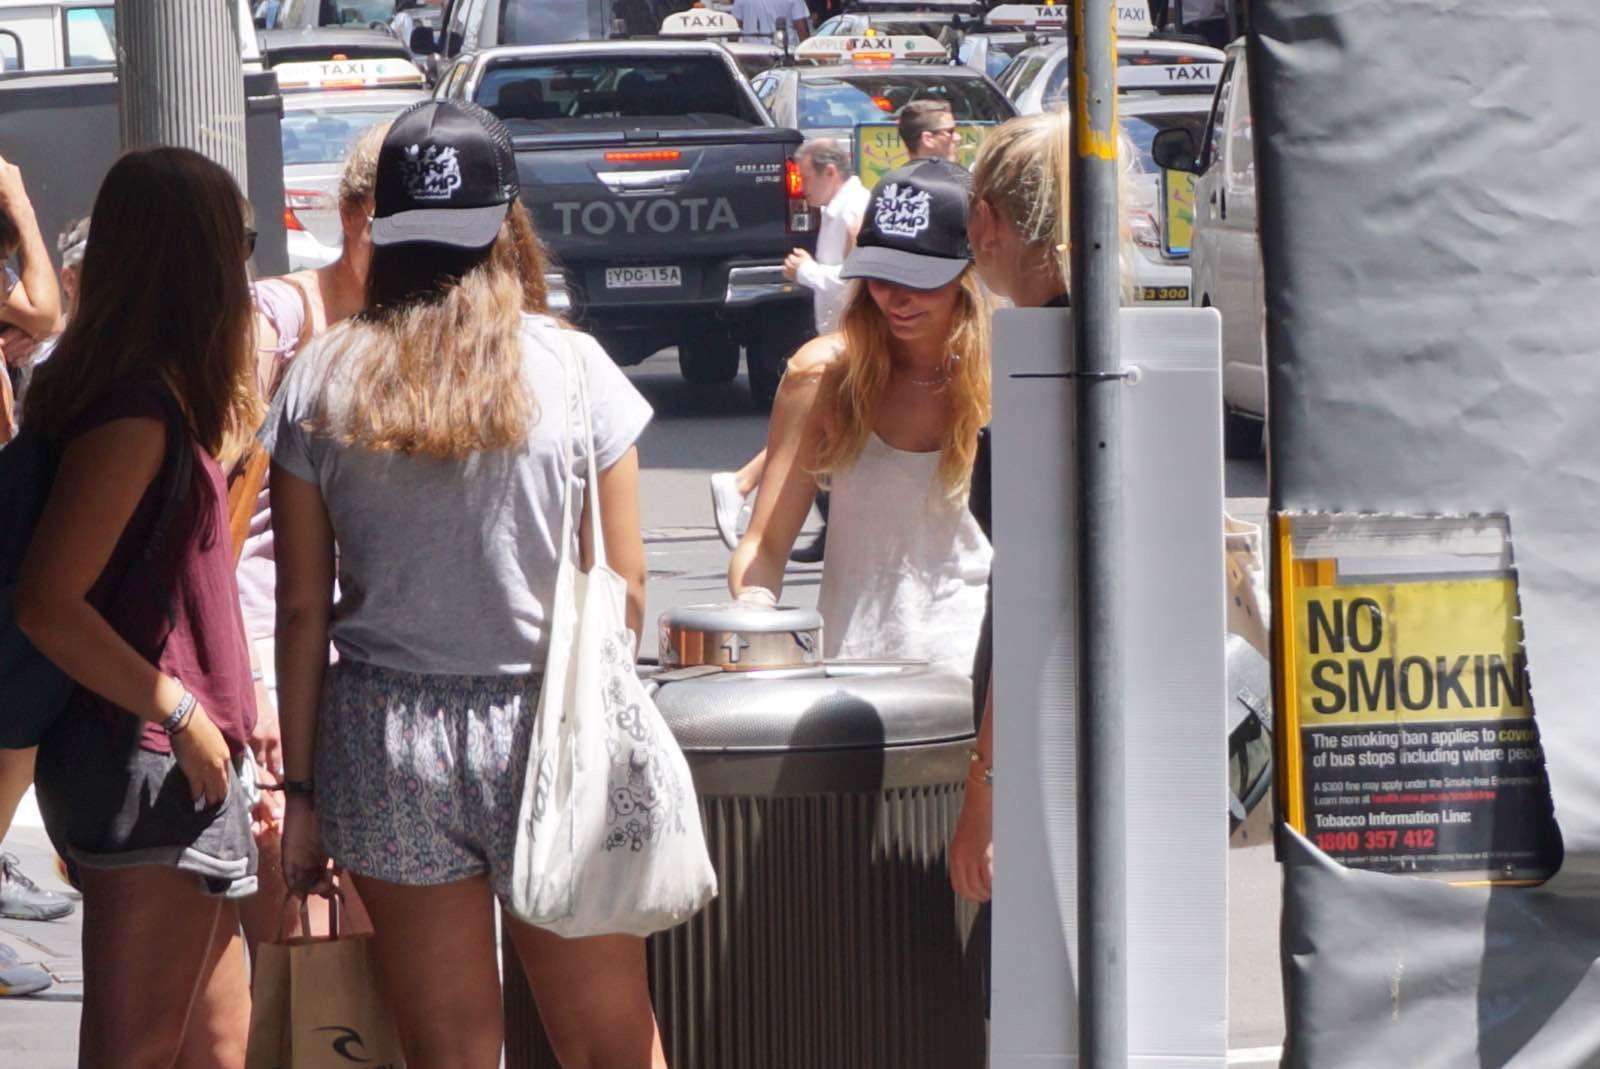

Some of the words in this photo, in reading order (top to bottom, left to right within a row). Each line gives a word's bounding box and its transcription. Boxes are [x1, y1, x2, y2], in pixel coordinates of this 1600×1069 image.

[1035, 7, 1064, 17] TAX
[1118, 8, 1145, 21] TAXI
[680, 15, 724, 27] TAXI
[852, 38, 893, 50] TAXI
[320, 63, 366, 76] TAXI
[1165, 66, 1211, 81] TAXI
[880, 198, 925, 214] SURF
[553, 197, 740, 236] TOYOTA
[876, 211, 926, 228] CAMP
[1307, 597, 1383, 655] NO
[1310, 653, 1525, 715] SMOKIN
[1311, 733, 1338, 749] The
[1341, 731, 1399, 749] smoking
[1402, 730, 1428, 746] ban
[1431, 728, 1479, 747] applies
[1482, 728, 1497, 743] to
[1313, 752, 1328, 768] of
[1330, 752, 1356, 767] bus
[1358, 751, 1395, 768] stops
[1400, 747, 1459, 766] including
[1462, 746, 1504, 762] where
[1315, 814, 1366, 828] Tobacco
[1368, 810, 1439, 826] Information
[1442, 809, 1472, 824] Line:
[1316, 831, 1359, 850] 1800
[1364, 830, 1398, 849] 357
[1403, 829, 1435, 848] 412
